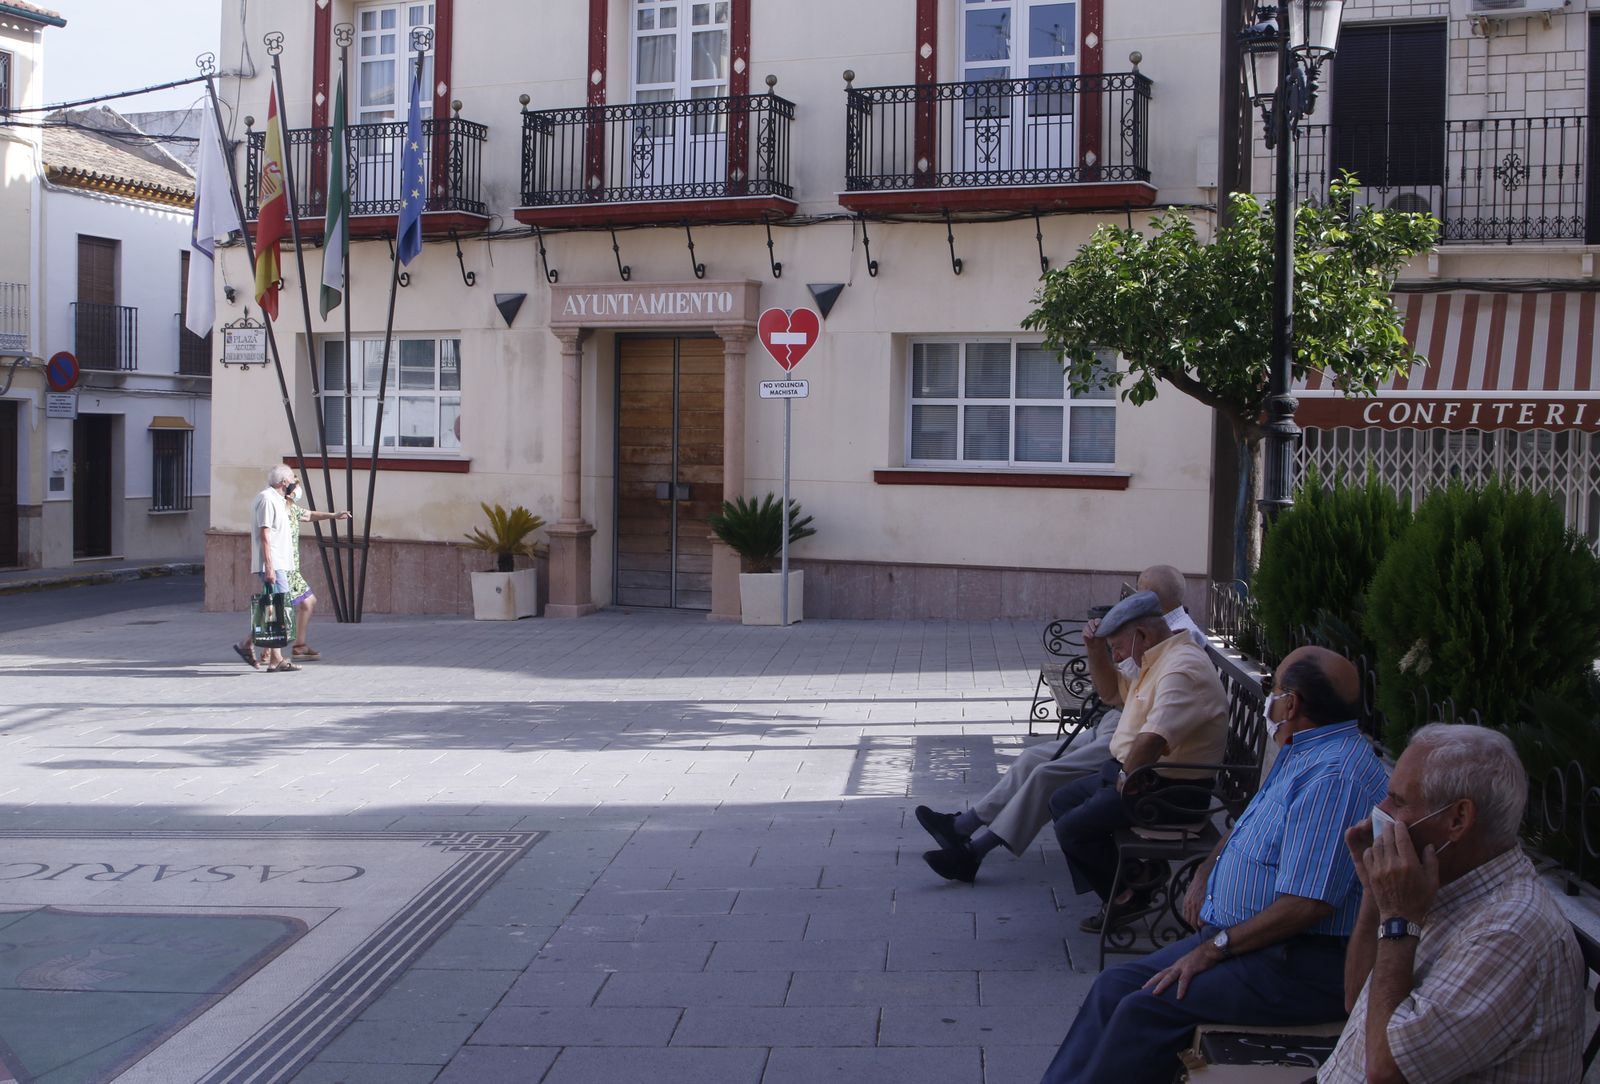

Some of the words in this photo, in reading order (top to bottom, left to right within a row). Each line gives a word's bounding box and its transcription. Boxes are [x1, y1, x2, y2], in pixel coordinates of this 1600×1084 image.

[562, 291, 733, 316] AYUNTAMIENTO
[96, 399, 100, 407] 7
[1363, 401, 1600, 426] CONFITERI
[0, 862, 366, 885] CASARIC
